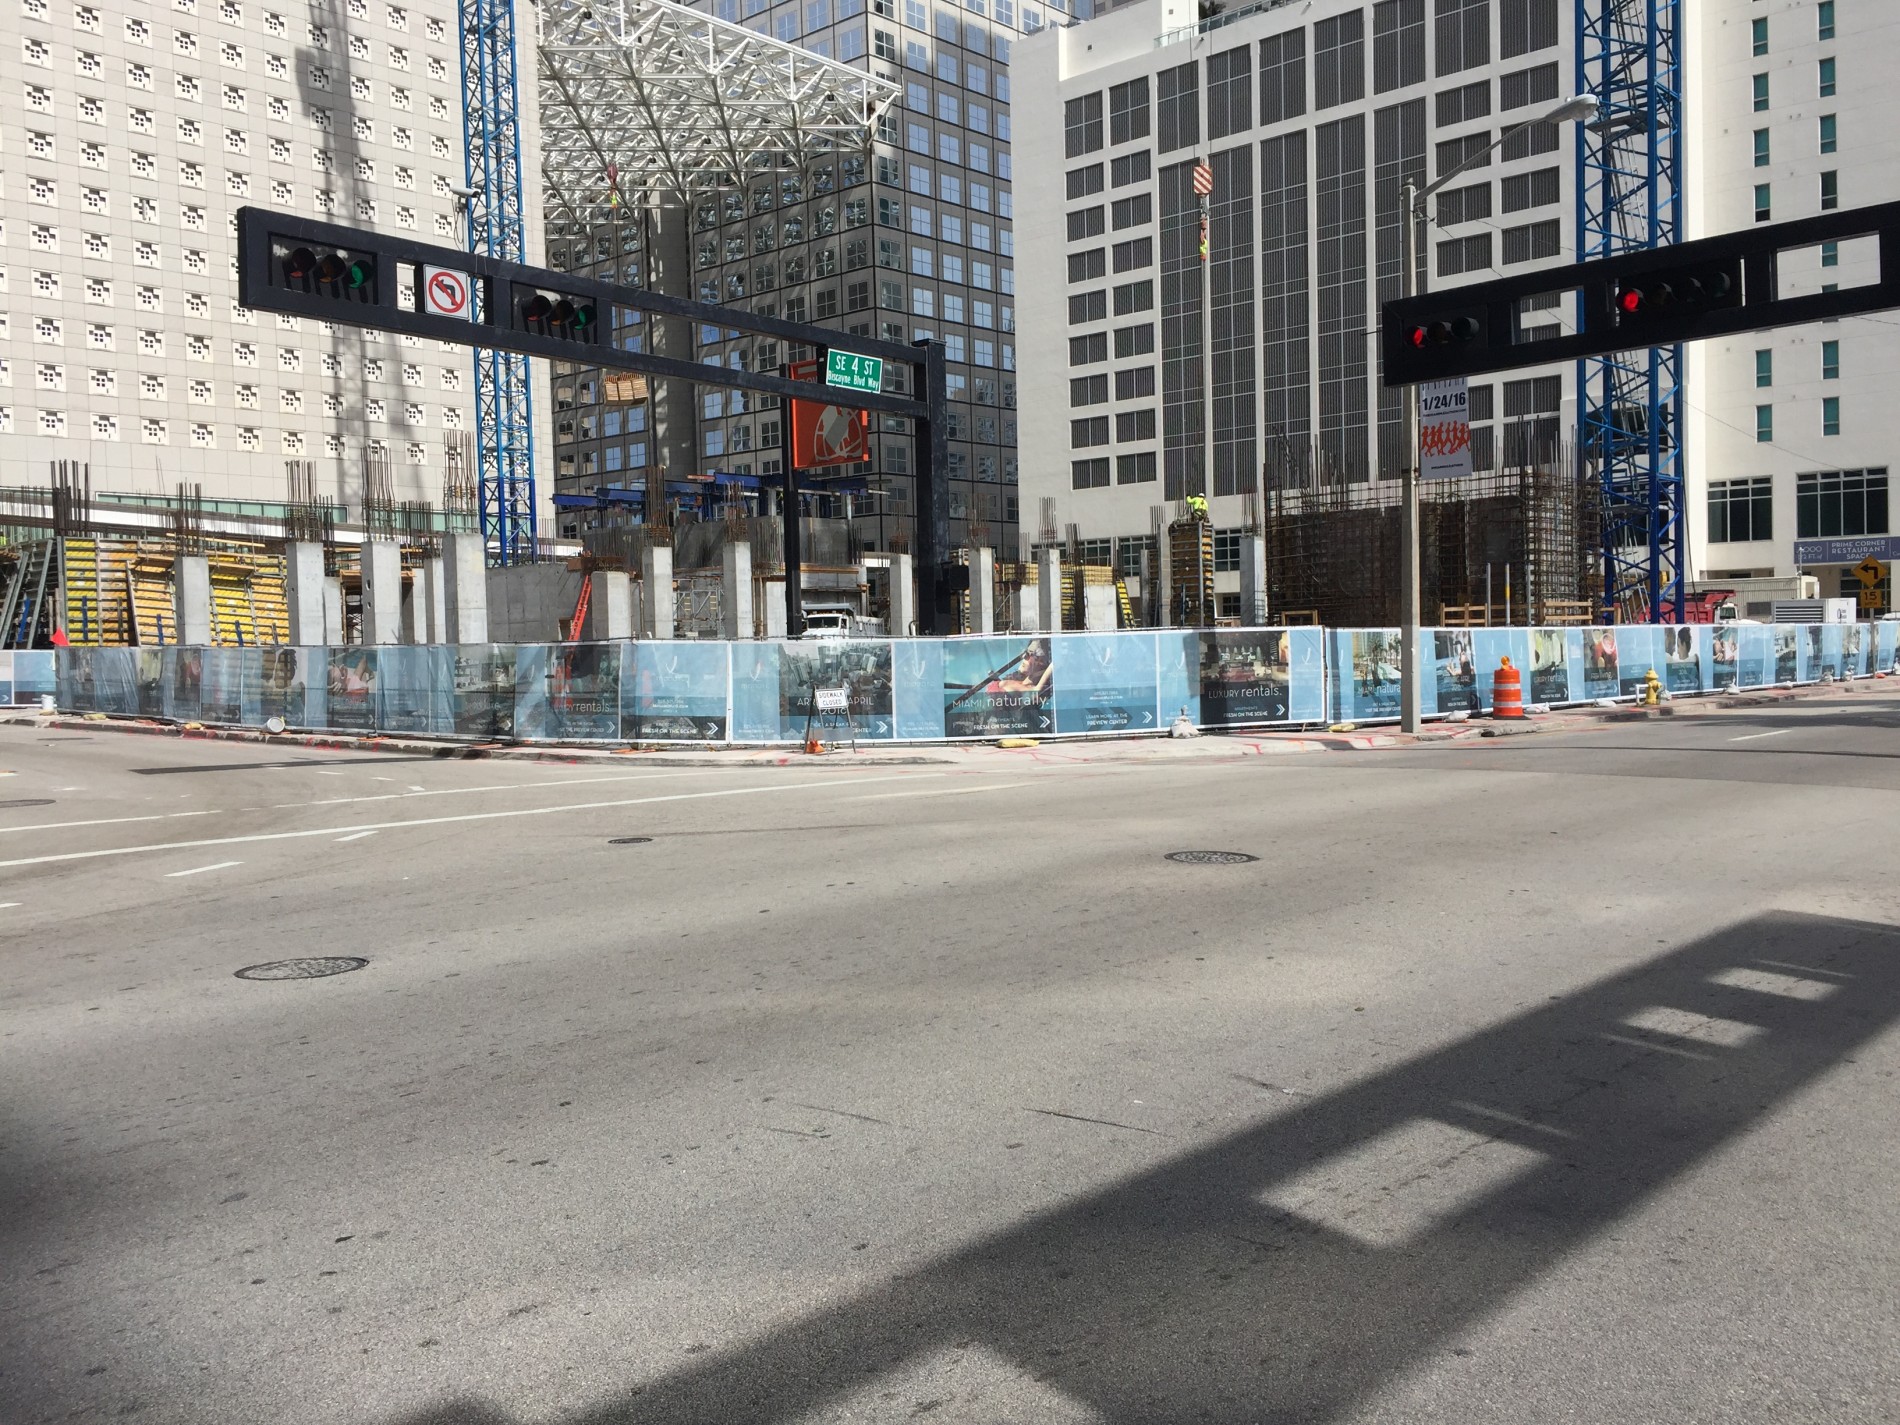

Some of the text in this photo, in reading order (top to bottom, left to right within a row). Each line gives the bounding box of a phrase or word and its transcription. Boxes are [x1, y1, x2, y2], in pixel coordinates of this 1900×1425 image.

[836, 355, 874, 375] SE 4 ST
[828, 370, 851, 385] Biscayne
[853, 374, 865, 386] Blvd
[868, 378, 880, 390] Way
[1422, 391, 1466, 411] 1/24/16
[1831, 546, 1885, 554] RESTAURANT
[1864, 591, 1878, 601] 15
[1208, 683, 1282, 699] LUXURY rentals.
[848, 696, 874, 705] APRIL
[987, 692, 1050, 709] naturally.
